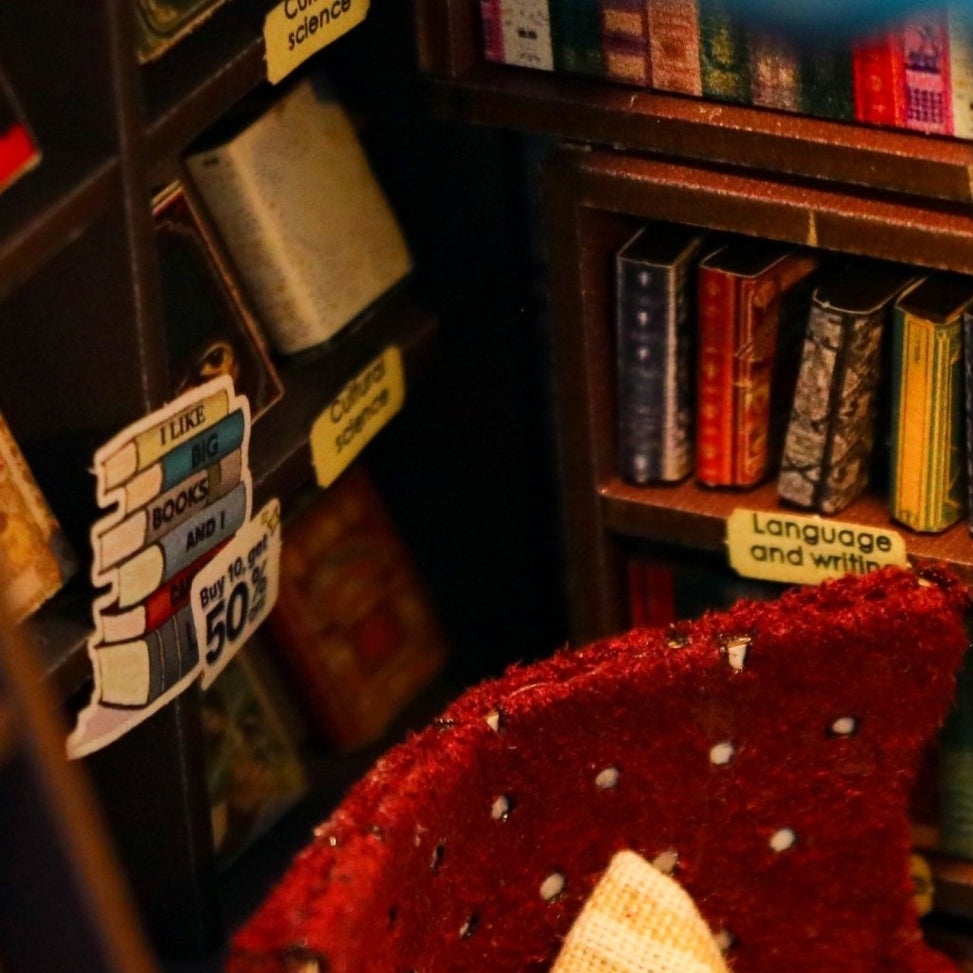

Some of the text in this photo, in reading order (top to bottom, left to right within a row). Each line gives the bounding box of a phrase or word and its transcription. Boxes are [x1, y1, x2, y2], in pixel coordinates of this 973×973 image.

[288, 0, 352, 51] science
[170, 404, 207, 439] LIKE
[152, 478, 210, 530] BOOKS
[186, 517, 217, 552] AND
[752, 512, 893, 554] Language
[750, 545, 882, 575] and writin
[199, 575, 225, 609] Buy
